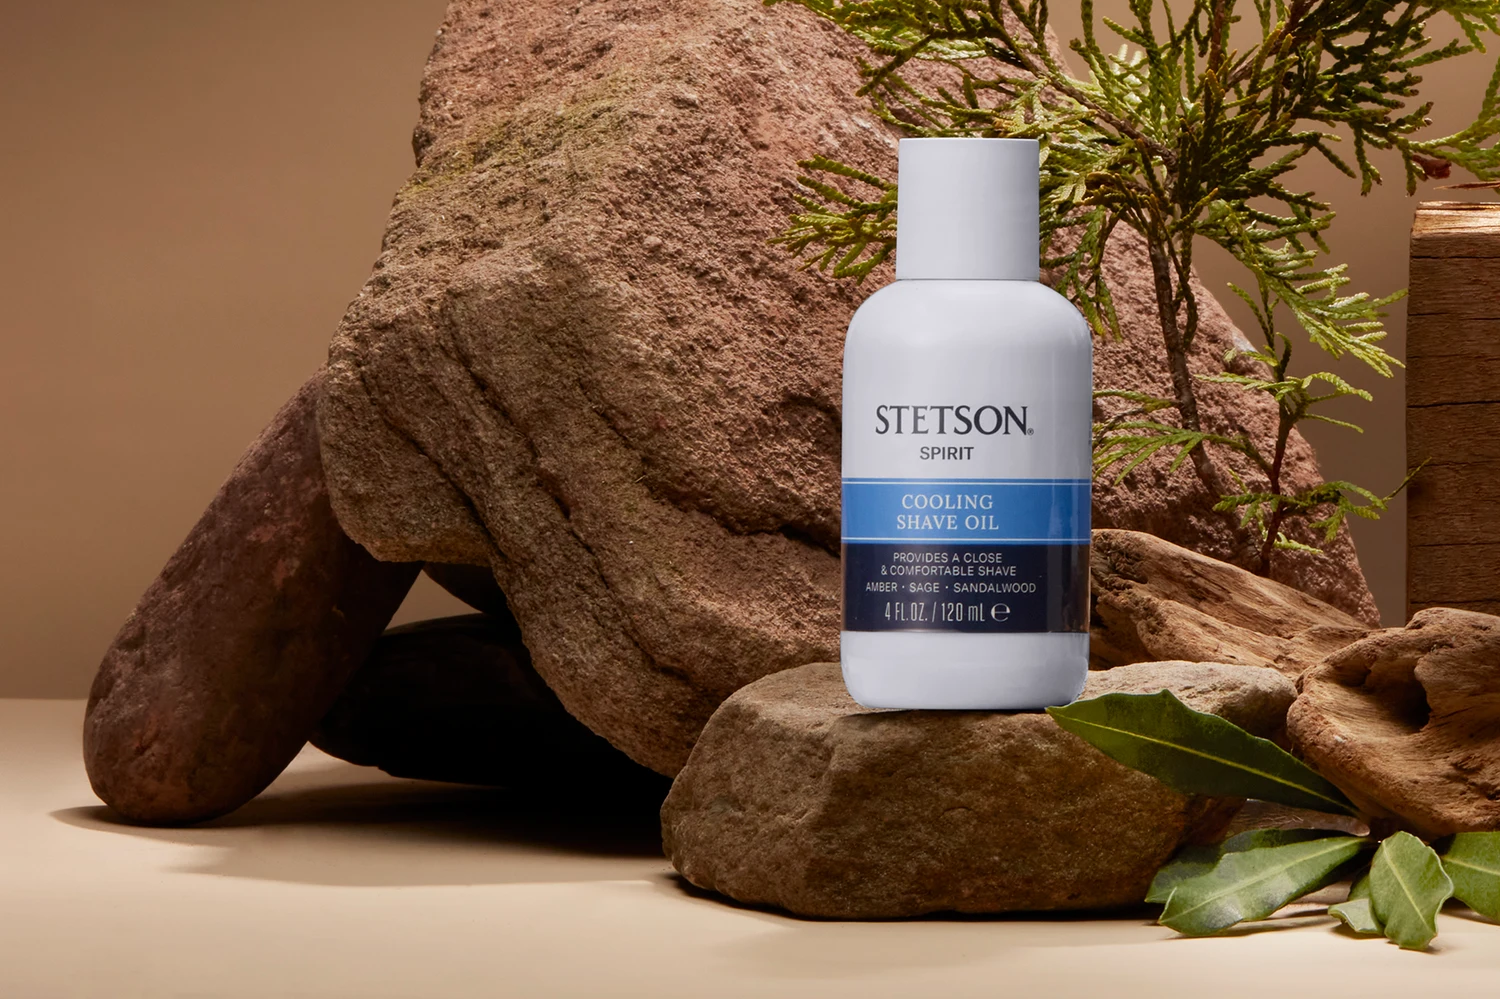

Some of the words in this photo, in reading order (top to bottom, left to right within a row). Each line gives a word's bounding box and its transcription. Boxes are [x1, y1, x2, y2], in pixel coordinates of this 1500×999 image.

[920, 447, 974, 460] SPIRIT
[902, 494, 993, 509] COOLING
[897, 515, 958, 530] SHAVE
[965, 515, 999, 530] OIL
[893, 553, 948, 563] PROVIDES
[952, 553, 960, 562] A
[963, 553, 1002, 563] CLOSE
[881, 566, 888, 575] &
[890, 566, 974, 576] COMFORTABLE
[978, 566, 1017, 576] SHAVE
[865, 582, 898, 592] AMBER
[909, 582, 940, 592] SAGE
[953, 583, 1036, 593] SANDALWOOD
[884, 602, 891, 620] 4
[942, 603, 963, 621] 120
